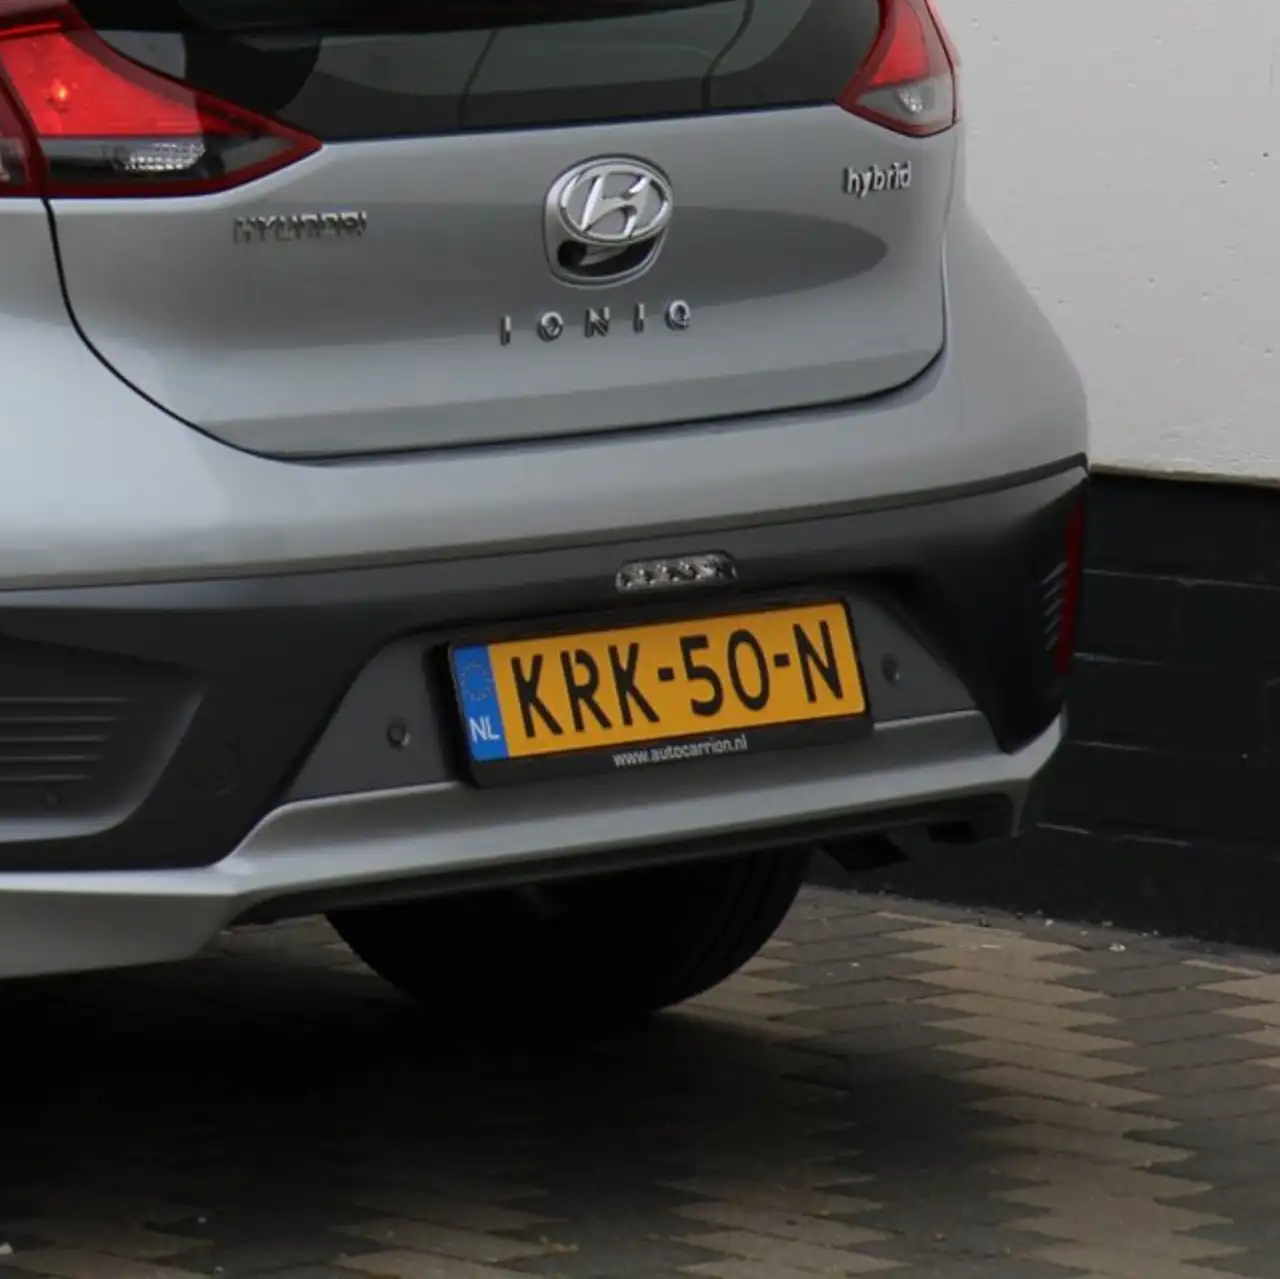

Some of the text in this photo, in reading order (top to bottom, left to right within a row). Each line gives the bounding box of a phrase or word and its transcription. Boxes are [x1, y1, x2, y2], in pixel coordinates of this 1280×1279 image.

[842, 160, 912, 200] hybrid
[500, 299, 691, 347] IONIQ
[469, 619, 844, 742] NL KRK-50-N
[612, 731, 749, 769] www.autocarrion.nl
